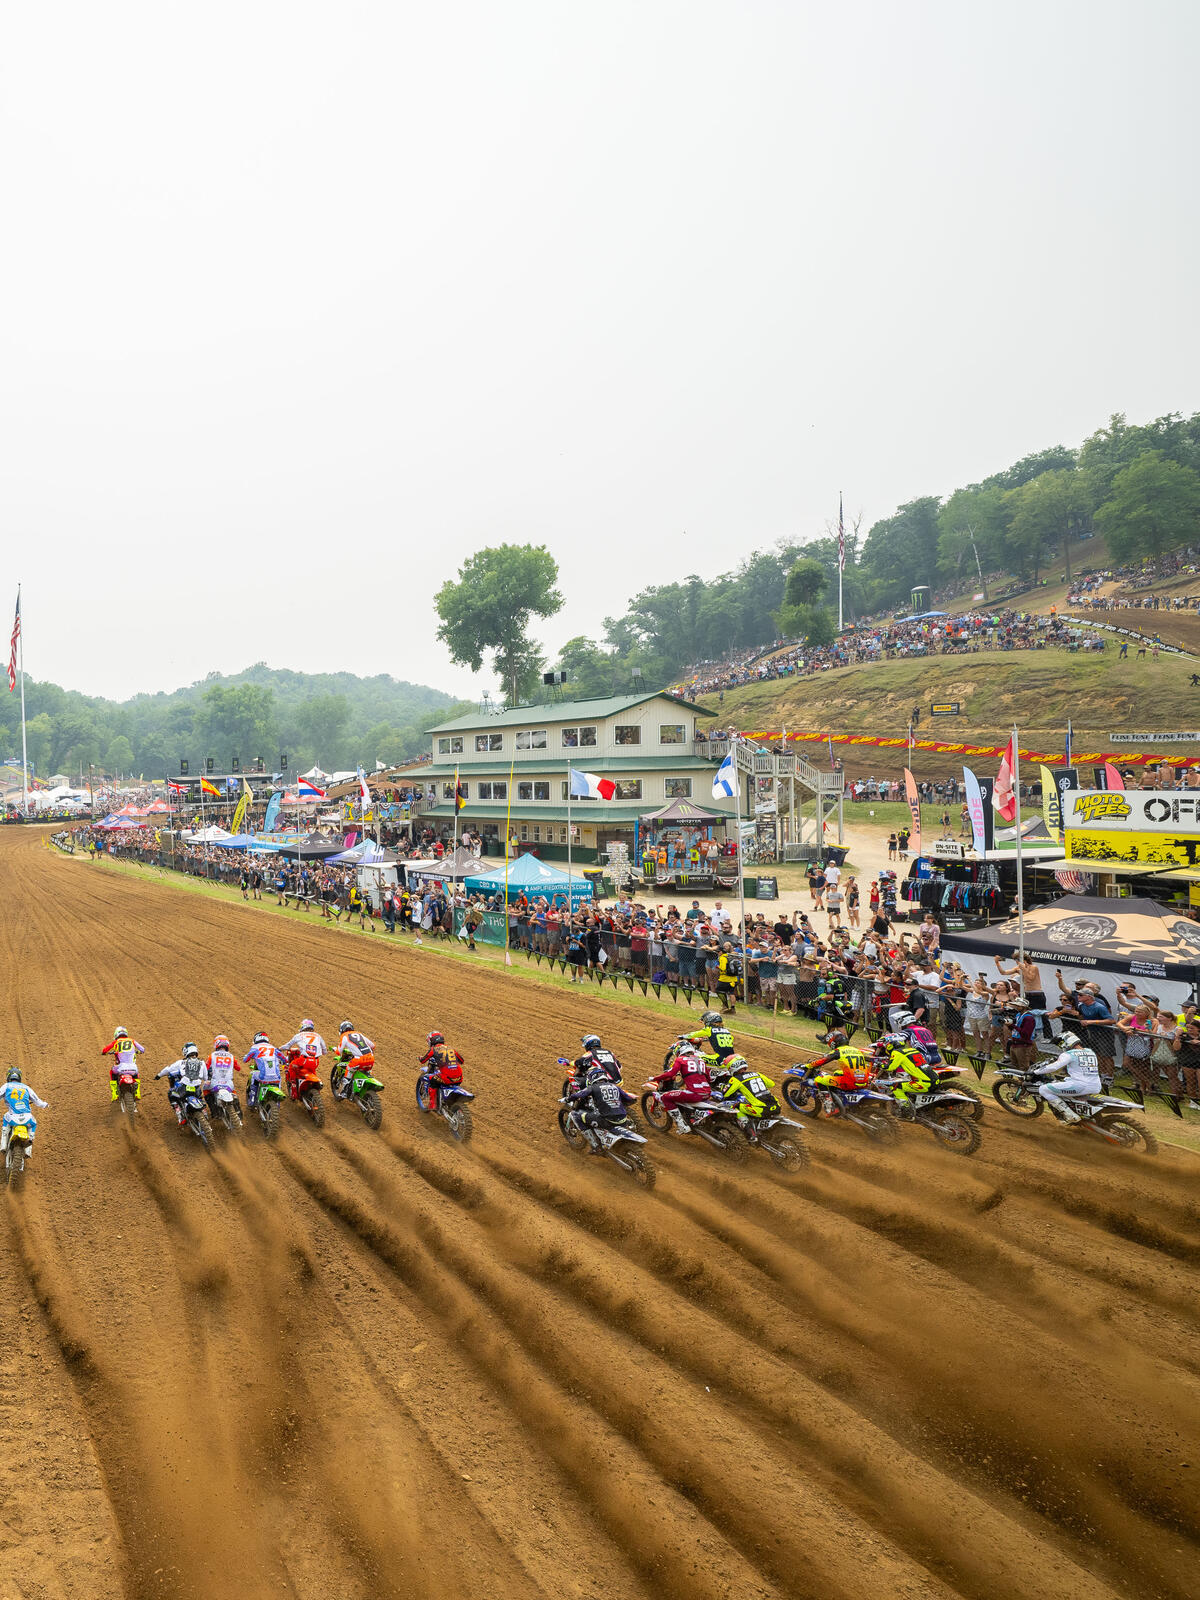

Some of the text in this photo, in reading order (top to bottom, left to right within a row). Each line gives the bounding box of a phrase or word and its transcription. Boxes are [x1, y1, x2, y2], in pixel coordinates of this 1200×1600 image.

[1049, 792, 1058, 828] RIDE
[1075, 793, 1124, 813] MOTO
[1082, 804, 1131, 821] TEES
[487, 916, 505, 927] THC
[1014, 949, 1097, 965] WW.MCGINLEYCLINIC.COM
[305, 1035, 316, 1044] 7
[257, 1047, 275, 1059] 21
[846, 1055, 866, 1069] 174
[749, 1077, 766, 1093] 66
[10, 1088, 27, 1101] 47
